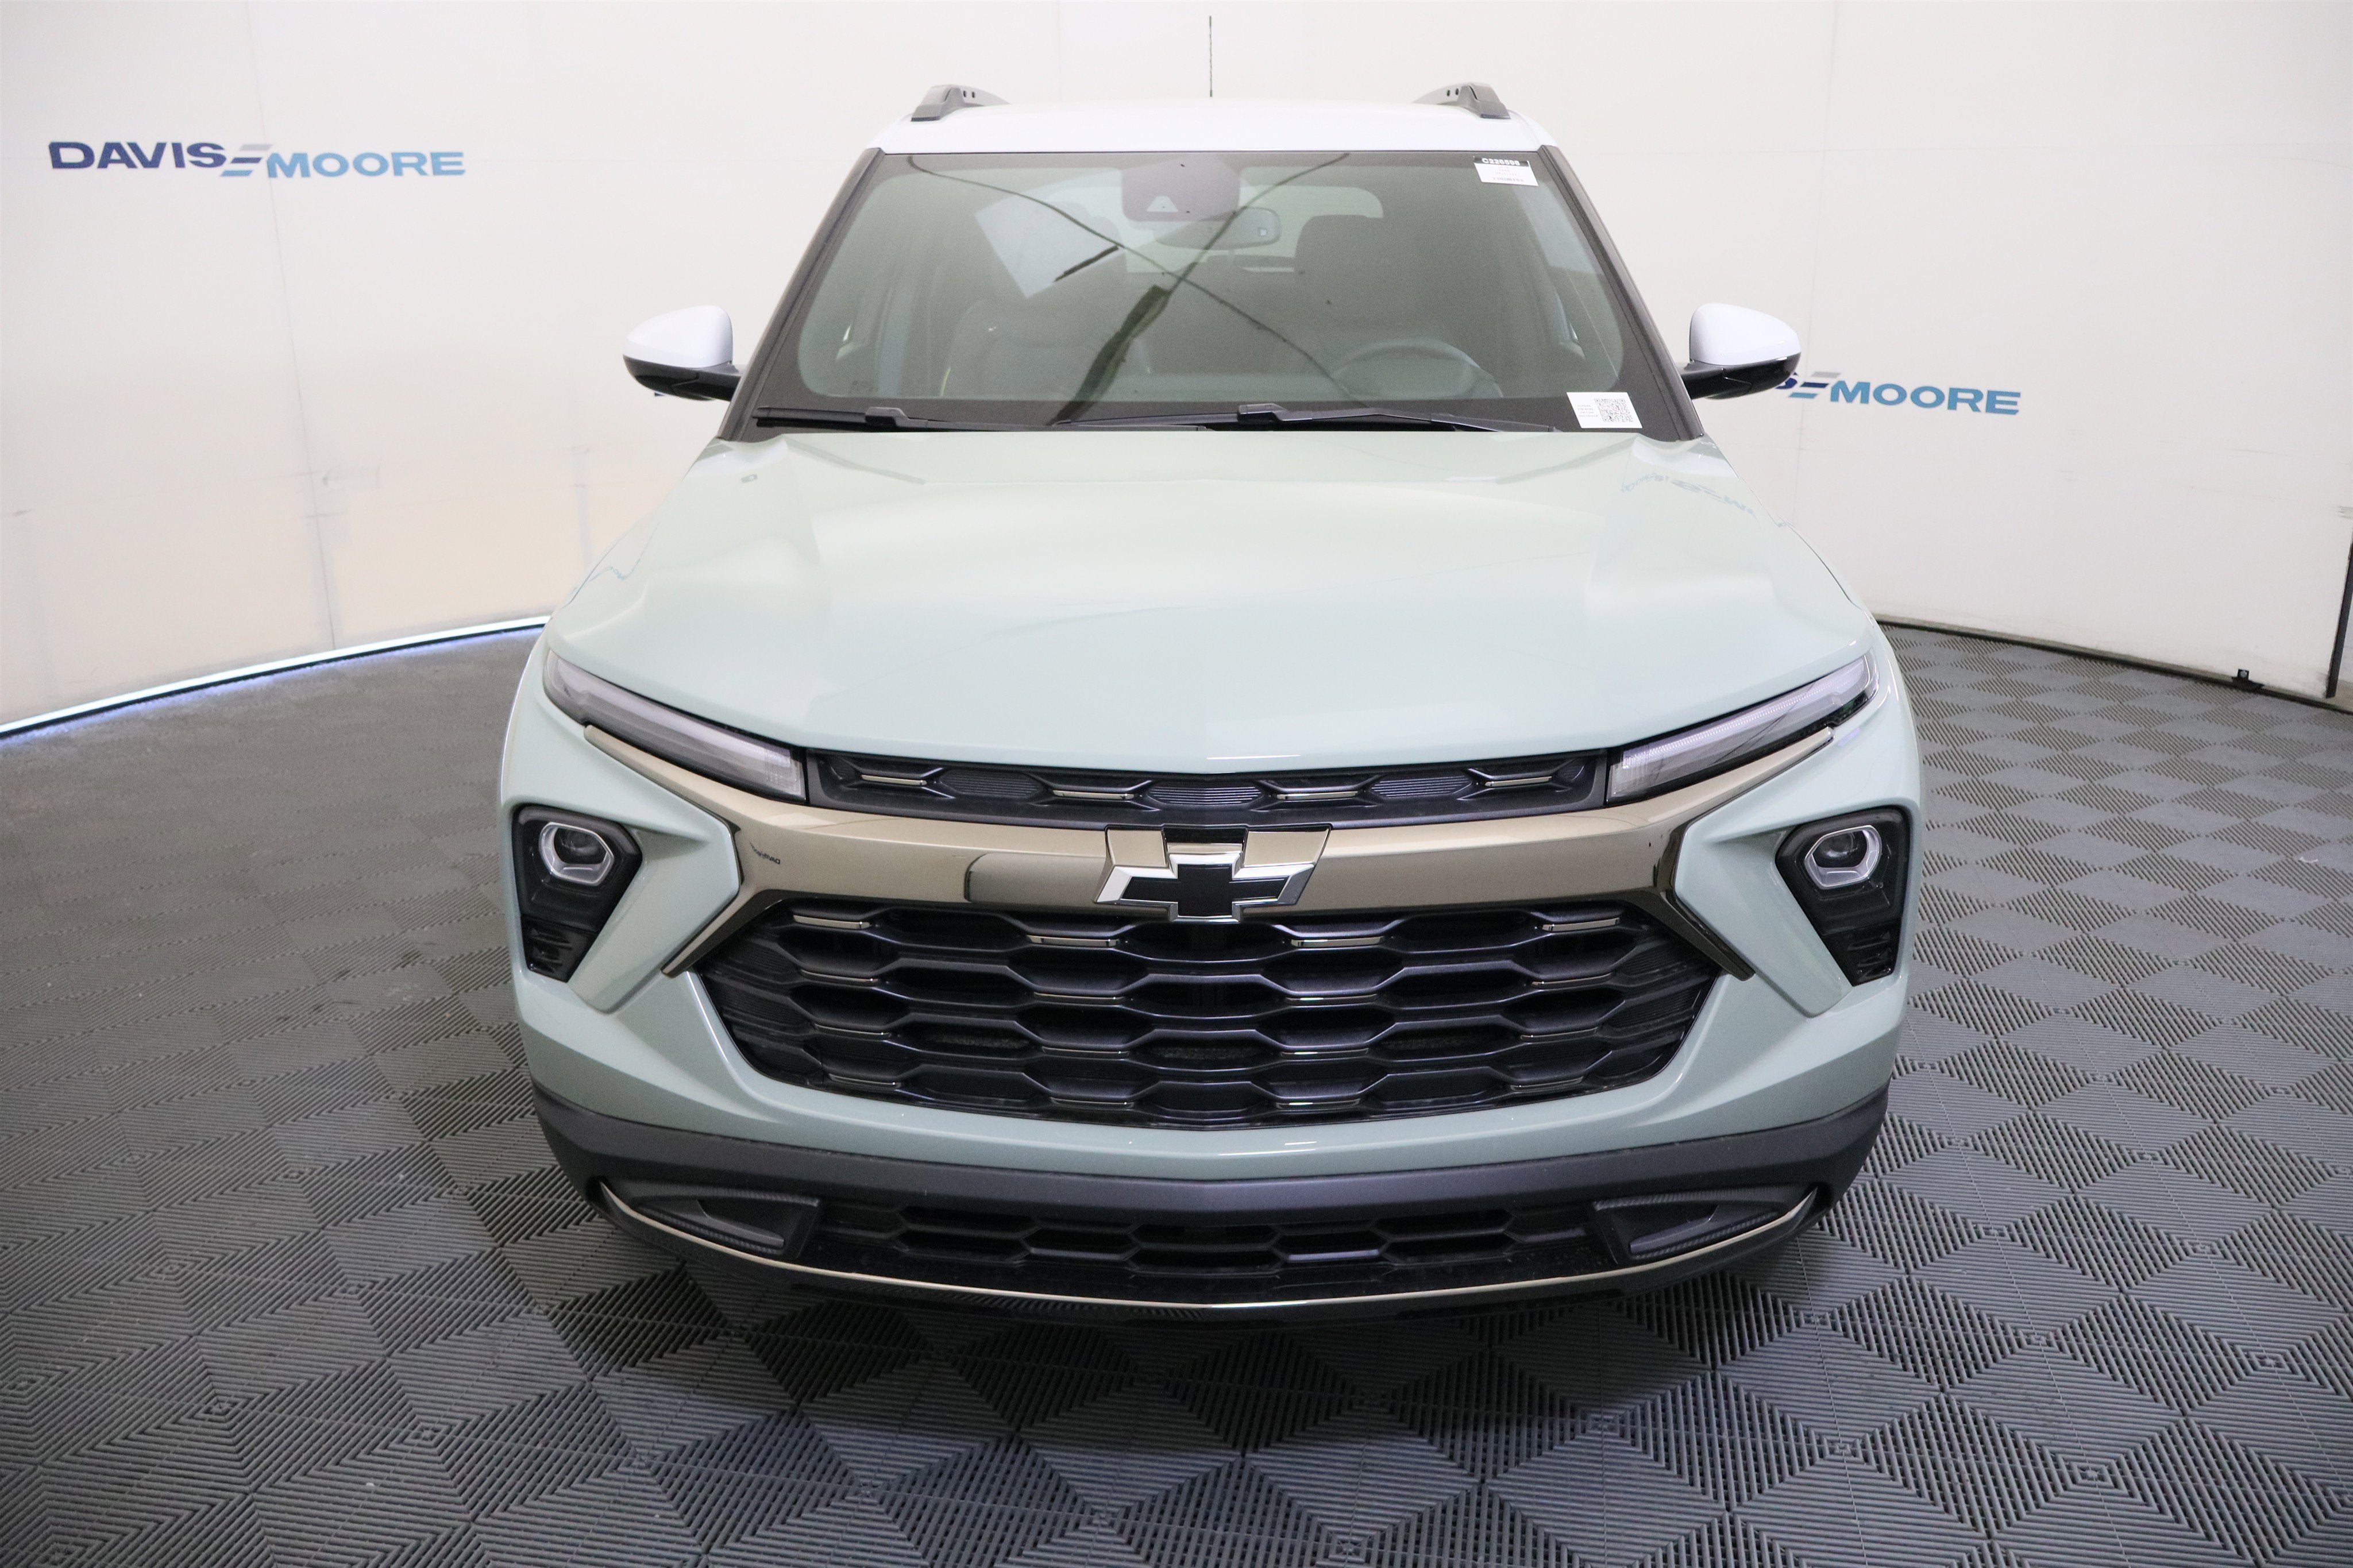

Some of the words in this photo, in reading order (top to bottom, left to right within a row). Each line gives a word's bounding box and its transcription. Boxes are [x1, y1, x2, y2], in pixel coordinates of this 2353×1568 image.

[49, 142, 225, 169] DAVIS
[267, 152, 466, 177] MOORE
[1830, 380, 2020, 415] MOORE
